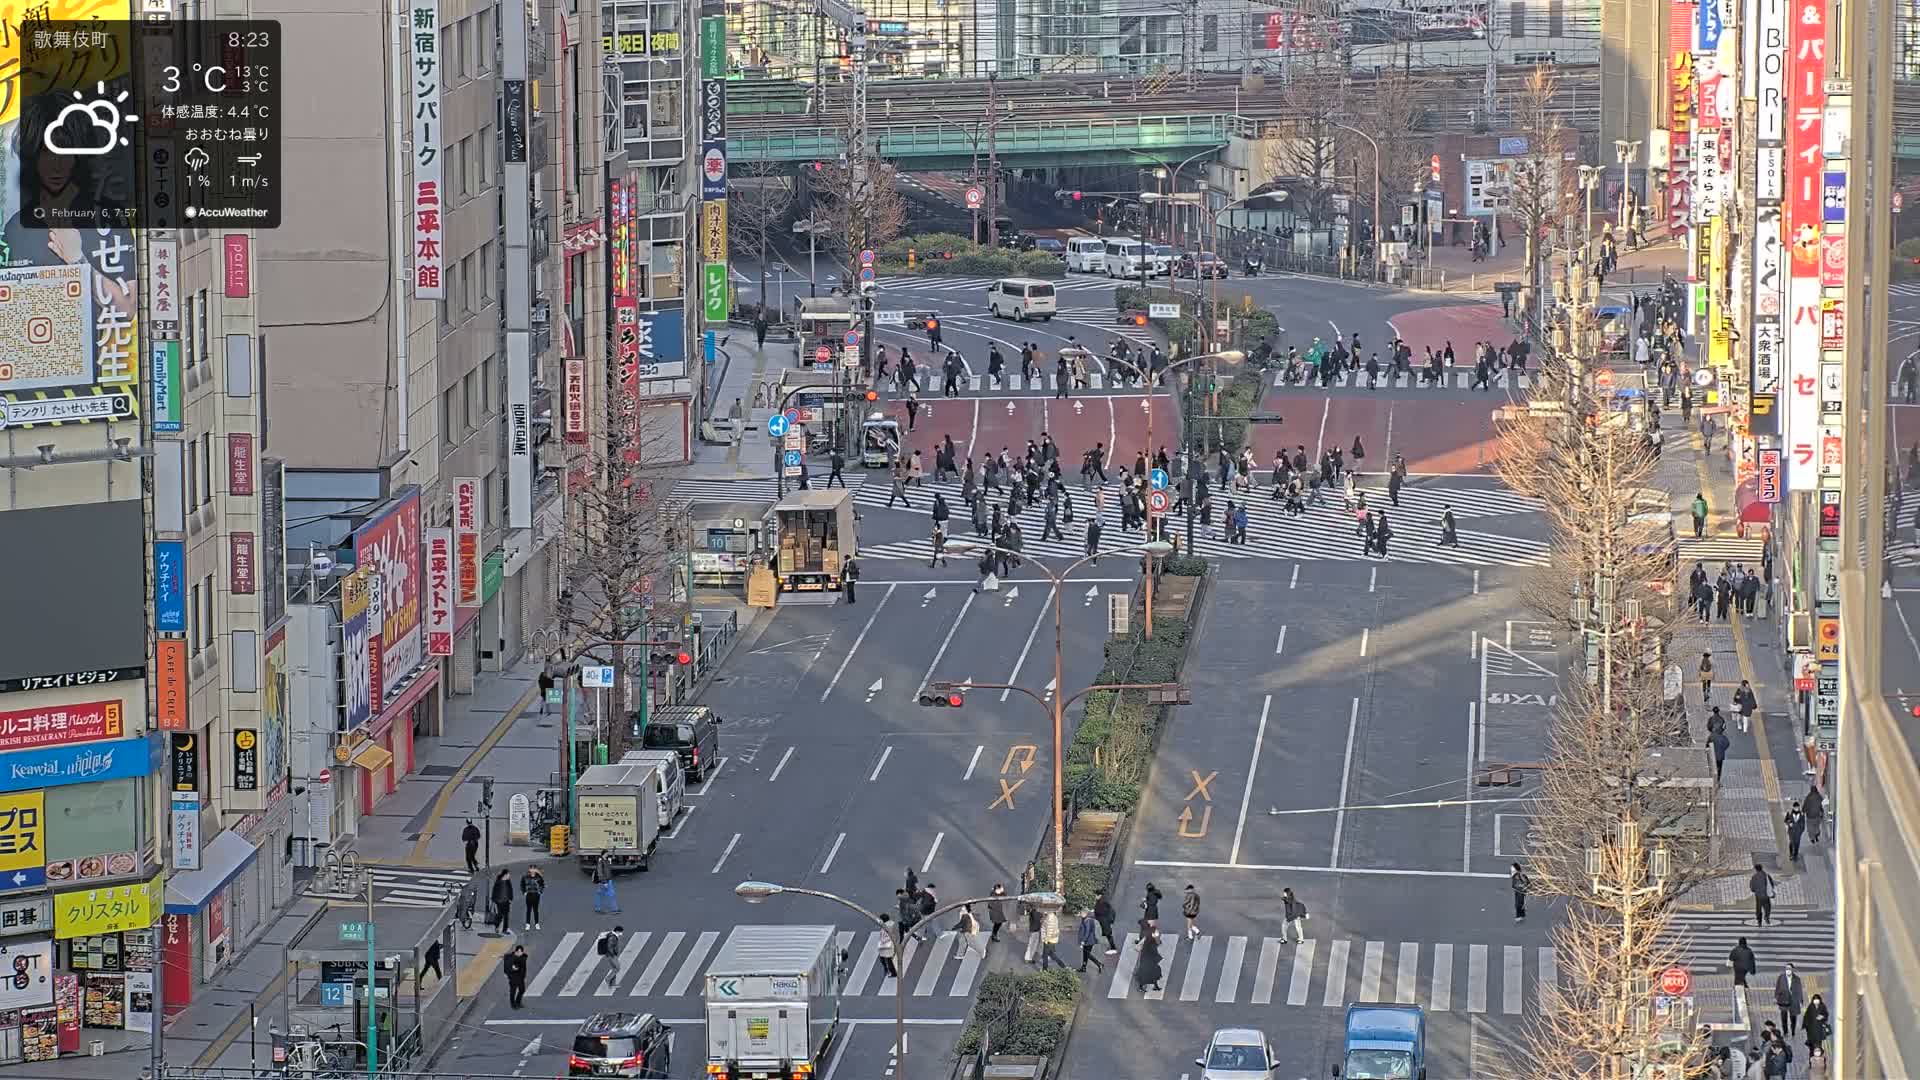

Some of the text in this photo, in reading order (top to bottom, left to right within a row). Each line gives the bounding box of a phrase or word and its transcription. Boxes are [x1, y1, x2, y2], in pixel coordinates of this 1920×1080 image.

[650, 32, 679, 51] 夜間
[414, 8, 437, 167] 新宿サンパーク
[1703, 84, 1716, 117] アコム
[1796, 38, 1824, 200] パーティー
[706, 157, 723, 174] 薬
[1671, 143, 1691, 230] エスパス
[416, 180, 441, 289] 三平本館
[709, 205, 722, 260] 肉汁水餃子
[708, 272, 722, 310] レイク
[1758, 326, 1772, 379] 大衆酒場
[154, 350, 168, 411] FamilyMart
[1793, 304, 1820, 466] パセラ
[12, 401, 109, 418] テンクリ たいせい先生
[459, 483, 470, 530] GAME
[159, 551, 170, 603] ゲウチャイ
[431, 538, 448, 626] 三平ストア
[0, 712, 67, 735] ルコ料理
[23, 731, 67, 744] RESTAURANT
[240, 731, 253, 747] 占
[0, 807, 38, 831] プロ
[0, 832, 38, 854] ミス
[3, 907, 37, 928] 囲碁
[68, 900, 140, 924] クリスタル
[325, 988, 340, 1001] 12
